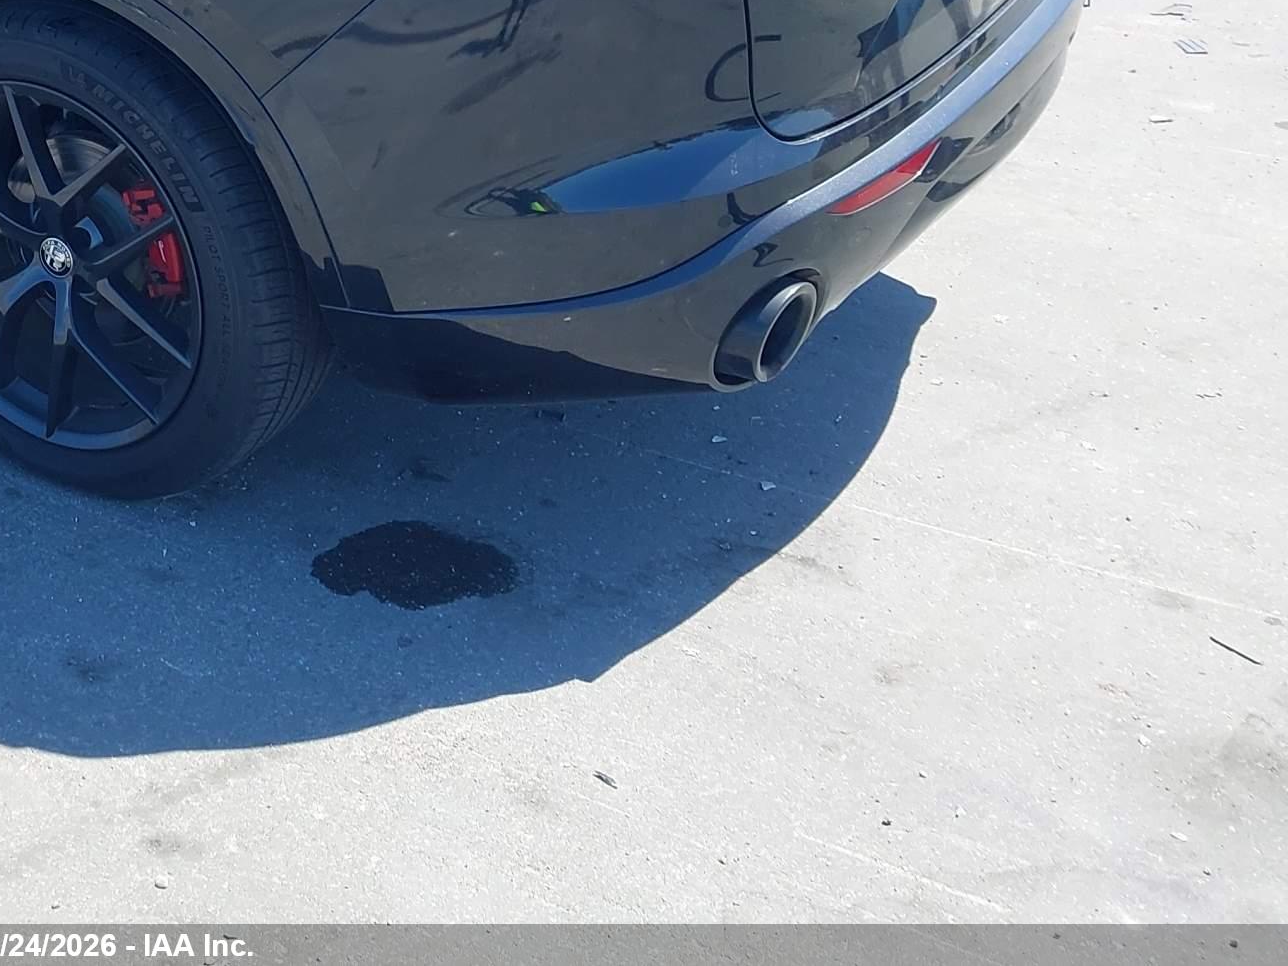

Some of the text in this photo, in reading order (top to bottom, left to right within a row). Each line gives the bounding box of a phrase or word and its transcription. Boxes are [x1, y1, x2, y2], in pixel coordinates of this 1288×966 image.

[91, 83, 200, 204] MICHELIN
[203, 225, 221, 262] PILOT
[214, 265, 231, 309] SPORT
